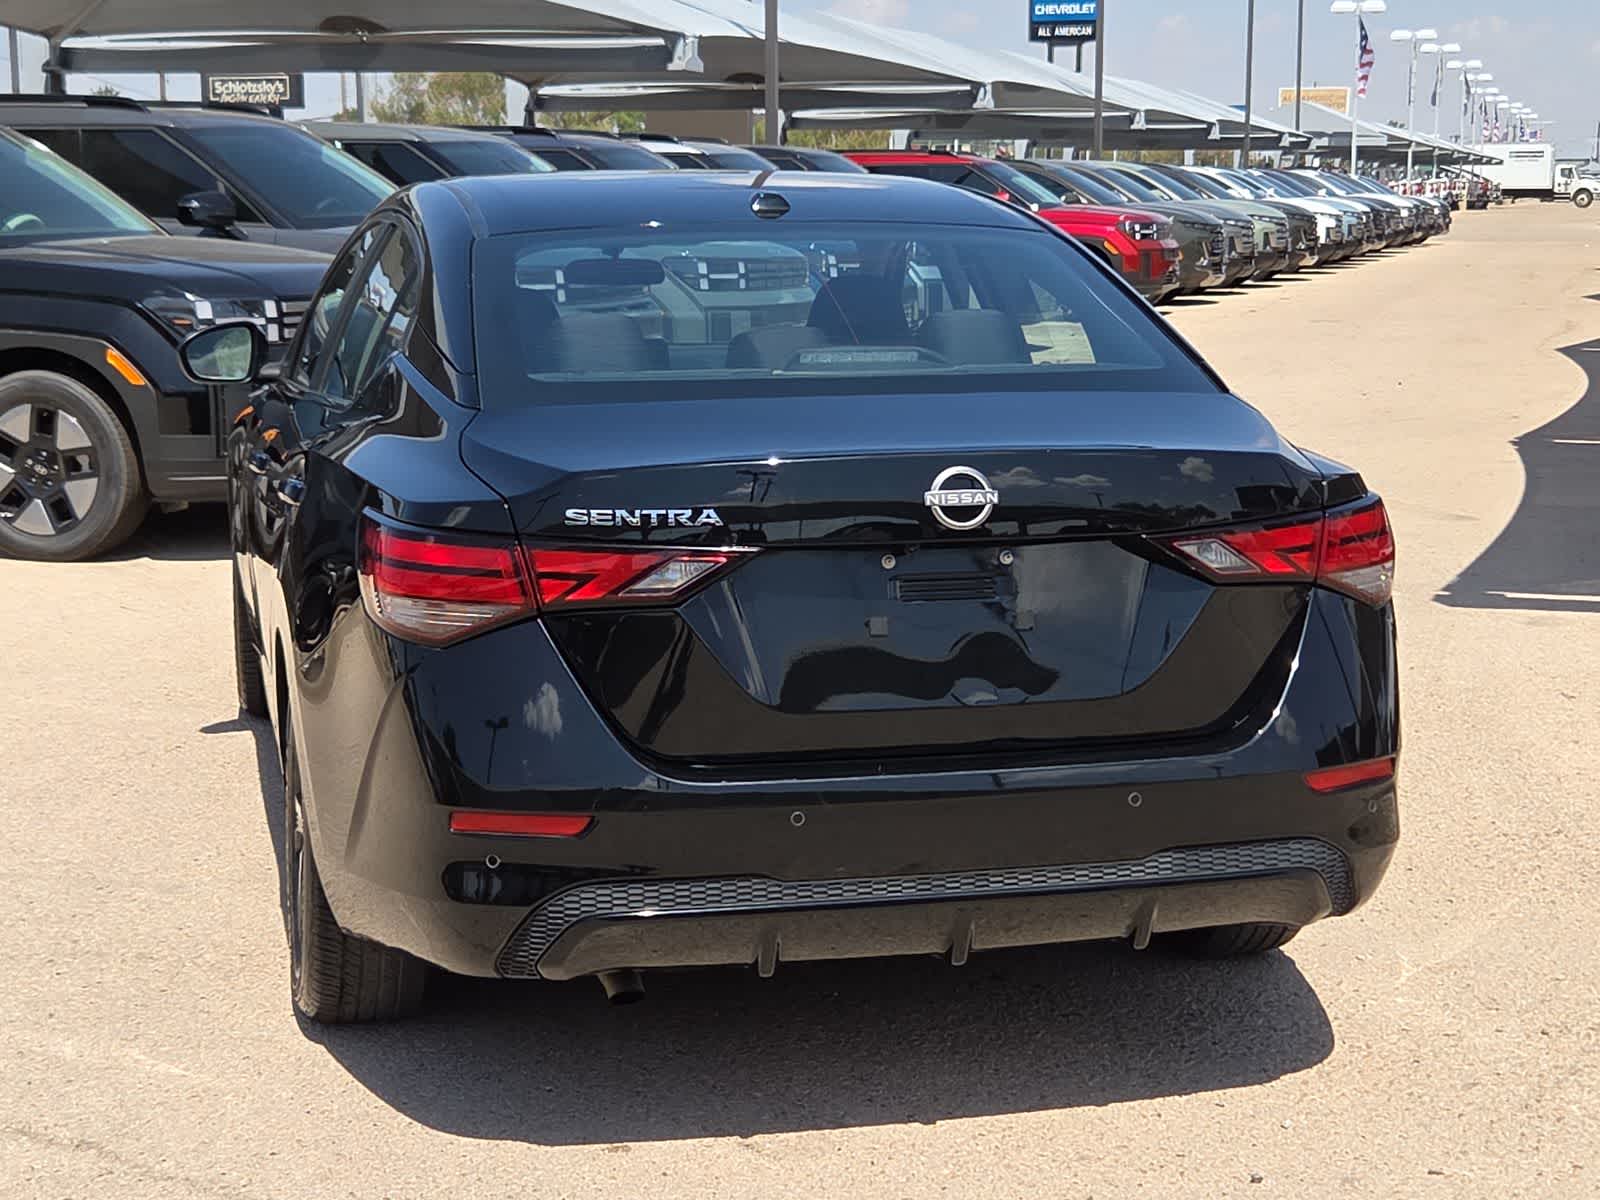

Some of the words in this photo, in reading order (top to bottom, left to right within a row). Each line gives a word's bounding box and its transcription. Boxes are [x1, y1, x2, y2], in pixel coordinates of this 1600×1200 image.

[1035, 4, 1096, 15] CHEVROLET
[1038, 27, 1051, 36] ALL
[1054, 26, 1092, 36] AMERICAN
[214, 81, 285, 96] Schlotzsky's
[926, 492, 998, 505] NISSAN
[564, 508, 724, 526] SENTRA
